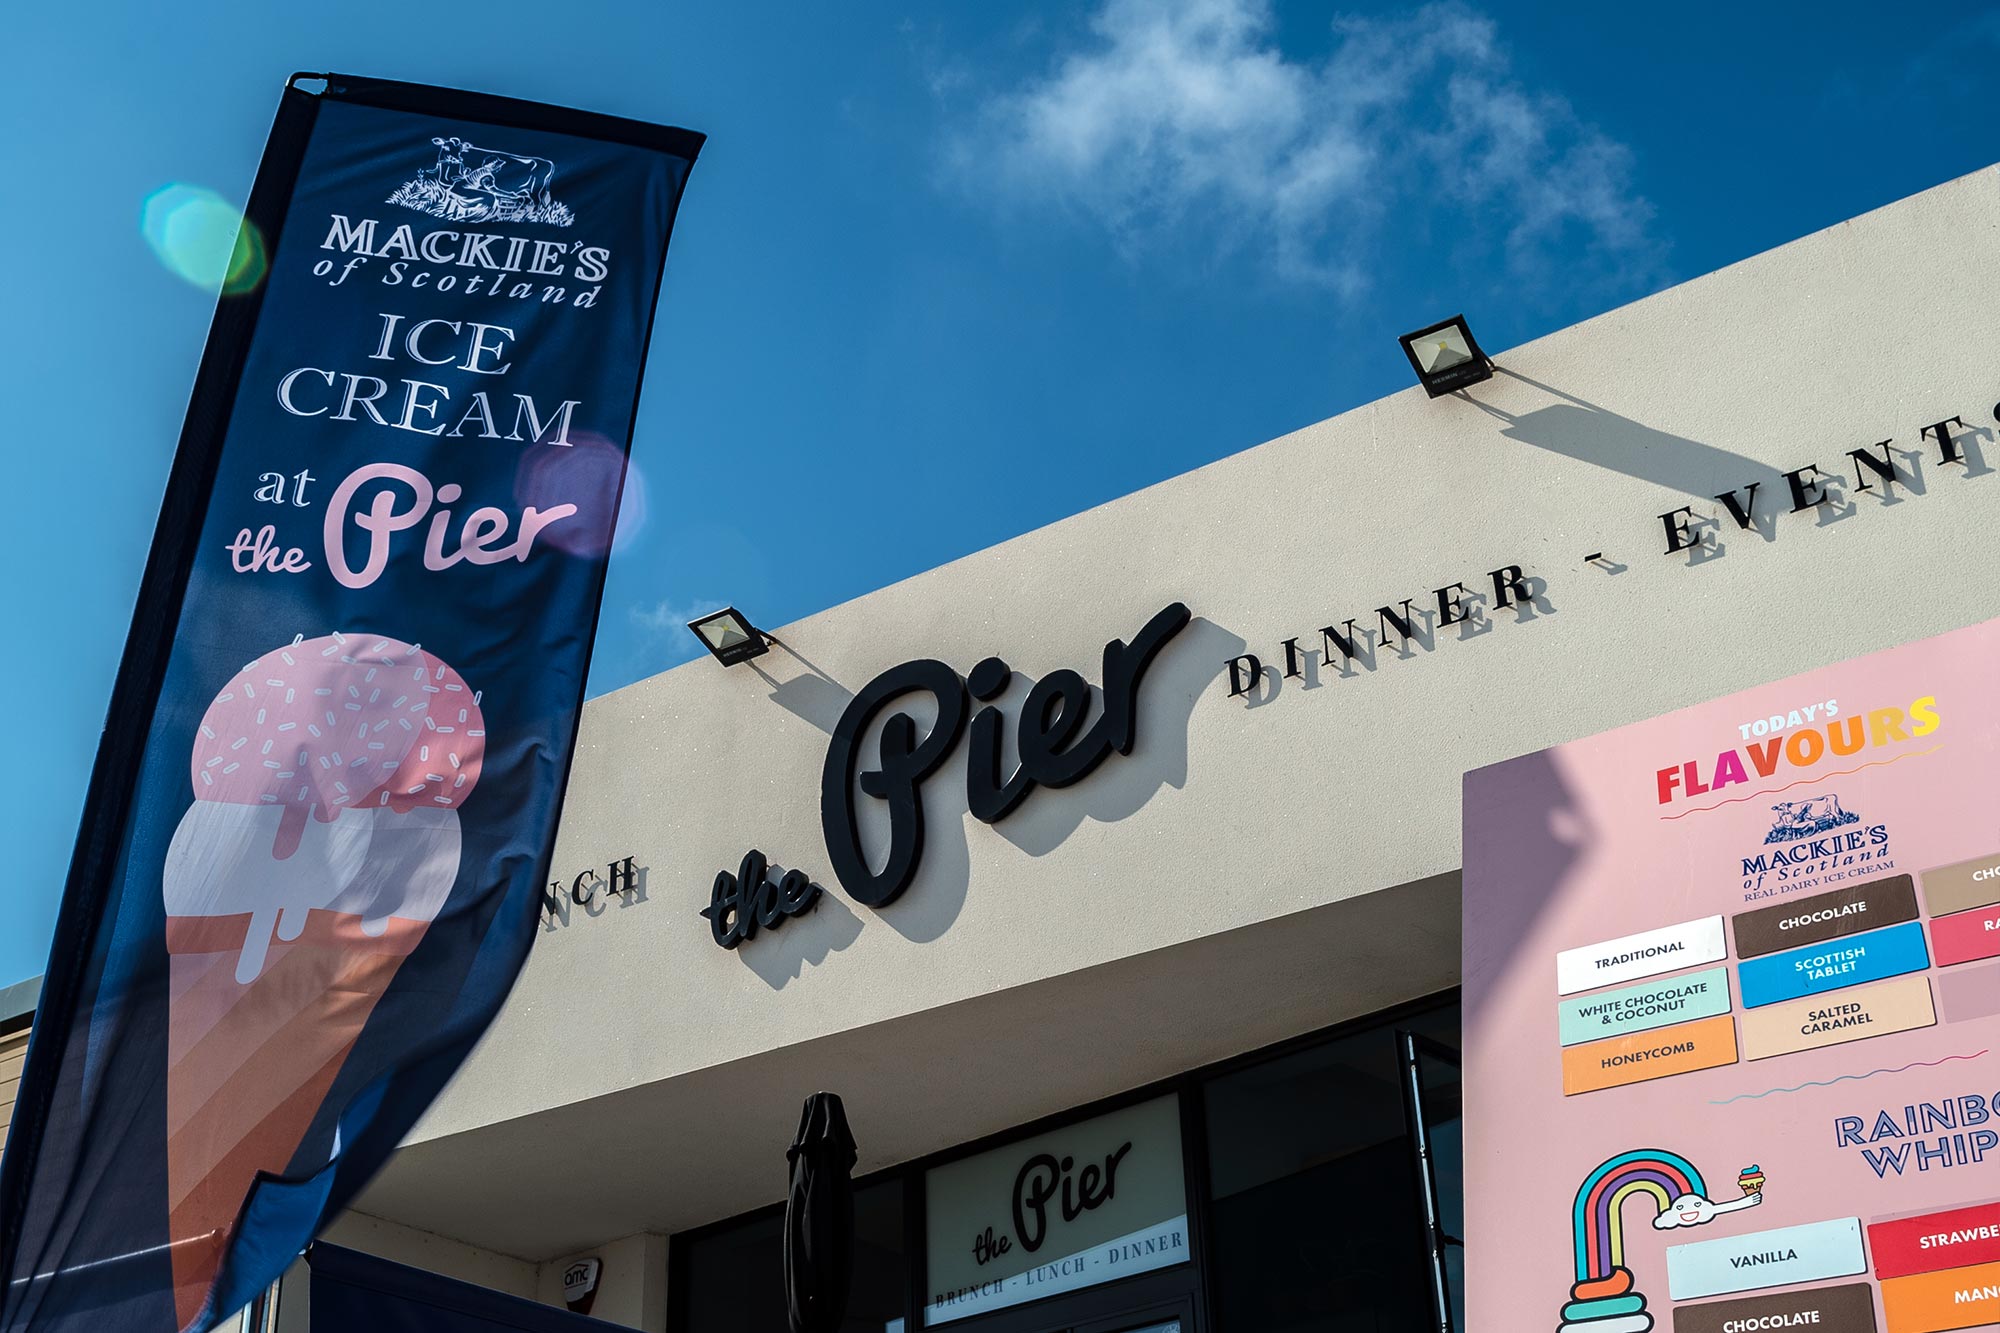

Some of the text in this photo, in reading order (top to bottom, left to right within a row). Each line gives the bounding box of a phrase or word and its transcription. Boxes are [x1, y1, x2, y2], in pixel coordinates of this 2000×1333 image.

[320, 214, 610, 282] MACKIE'S
[312, 257, 602, 308] of Scotland
[368, 313, 515, 375] ICE
[276, 367, 581, 447] CREAM
[253, 468, 316, 507] at
[225, 462, 578, 589] the Pier
[1224, 565, 1533, 698] DINNER
[1657, 401, 2000, 555] EVENT
[1738, 699, 1839, 741] TODAY'S
[1656, 696, 1941, 805] FLAVOURS
[700, 602, 1192, 950] the Pier
[1741, 824, 1889, 876] MACKIE'S
[1743, 843, 1889, 891] of Scotland
[1744, 860, 1895, 902] REAL DAIRY ICE CREAM
[1778, 901, 1867, 931] CHOCOLATE
[1594, 941, 1685, 969] TRADITIONAL
[1795, 946, 1866, 972] SCOTTISH
[1807, 961, 1857, 981] TABLET
[1578, 983, 1708, 1018] WHITE CHOCOLATE
[1601, 999, 1686, 1025] & COCONUT
[1808, 1002, 1861, 1022] SALTED
[1800, 1012, 1873, 1035] CARAMEL
[1601, 1041, 1695, 1069] HONEYCOMB
[1861, 1129, 1999, 1179] WHIP
[972, 1141, 1132, 1266] the Pier
[1920, 1224, 2000, 1249] STRAWBE
[935, 1278, 1004, 1309] BRUNCH
[1026, 1257, 1086, 1286] LUNCH
[1109, 1231, 1183, 1265] DINNER
[1730, 1248, 1798, 1269] VANILLA
[1954, 1285, 2000, 1304] MAN
[1722, 1310, 1820, 1333] CHOCOLATE
